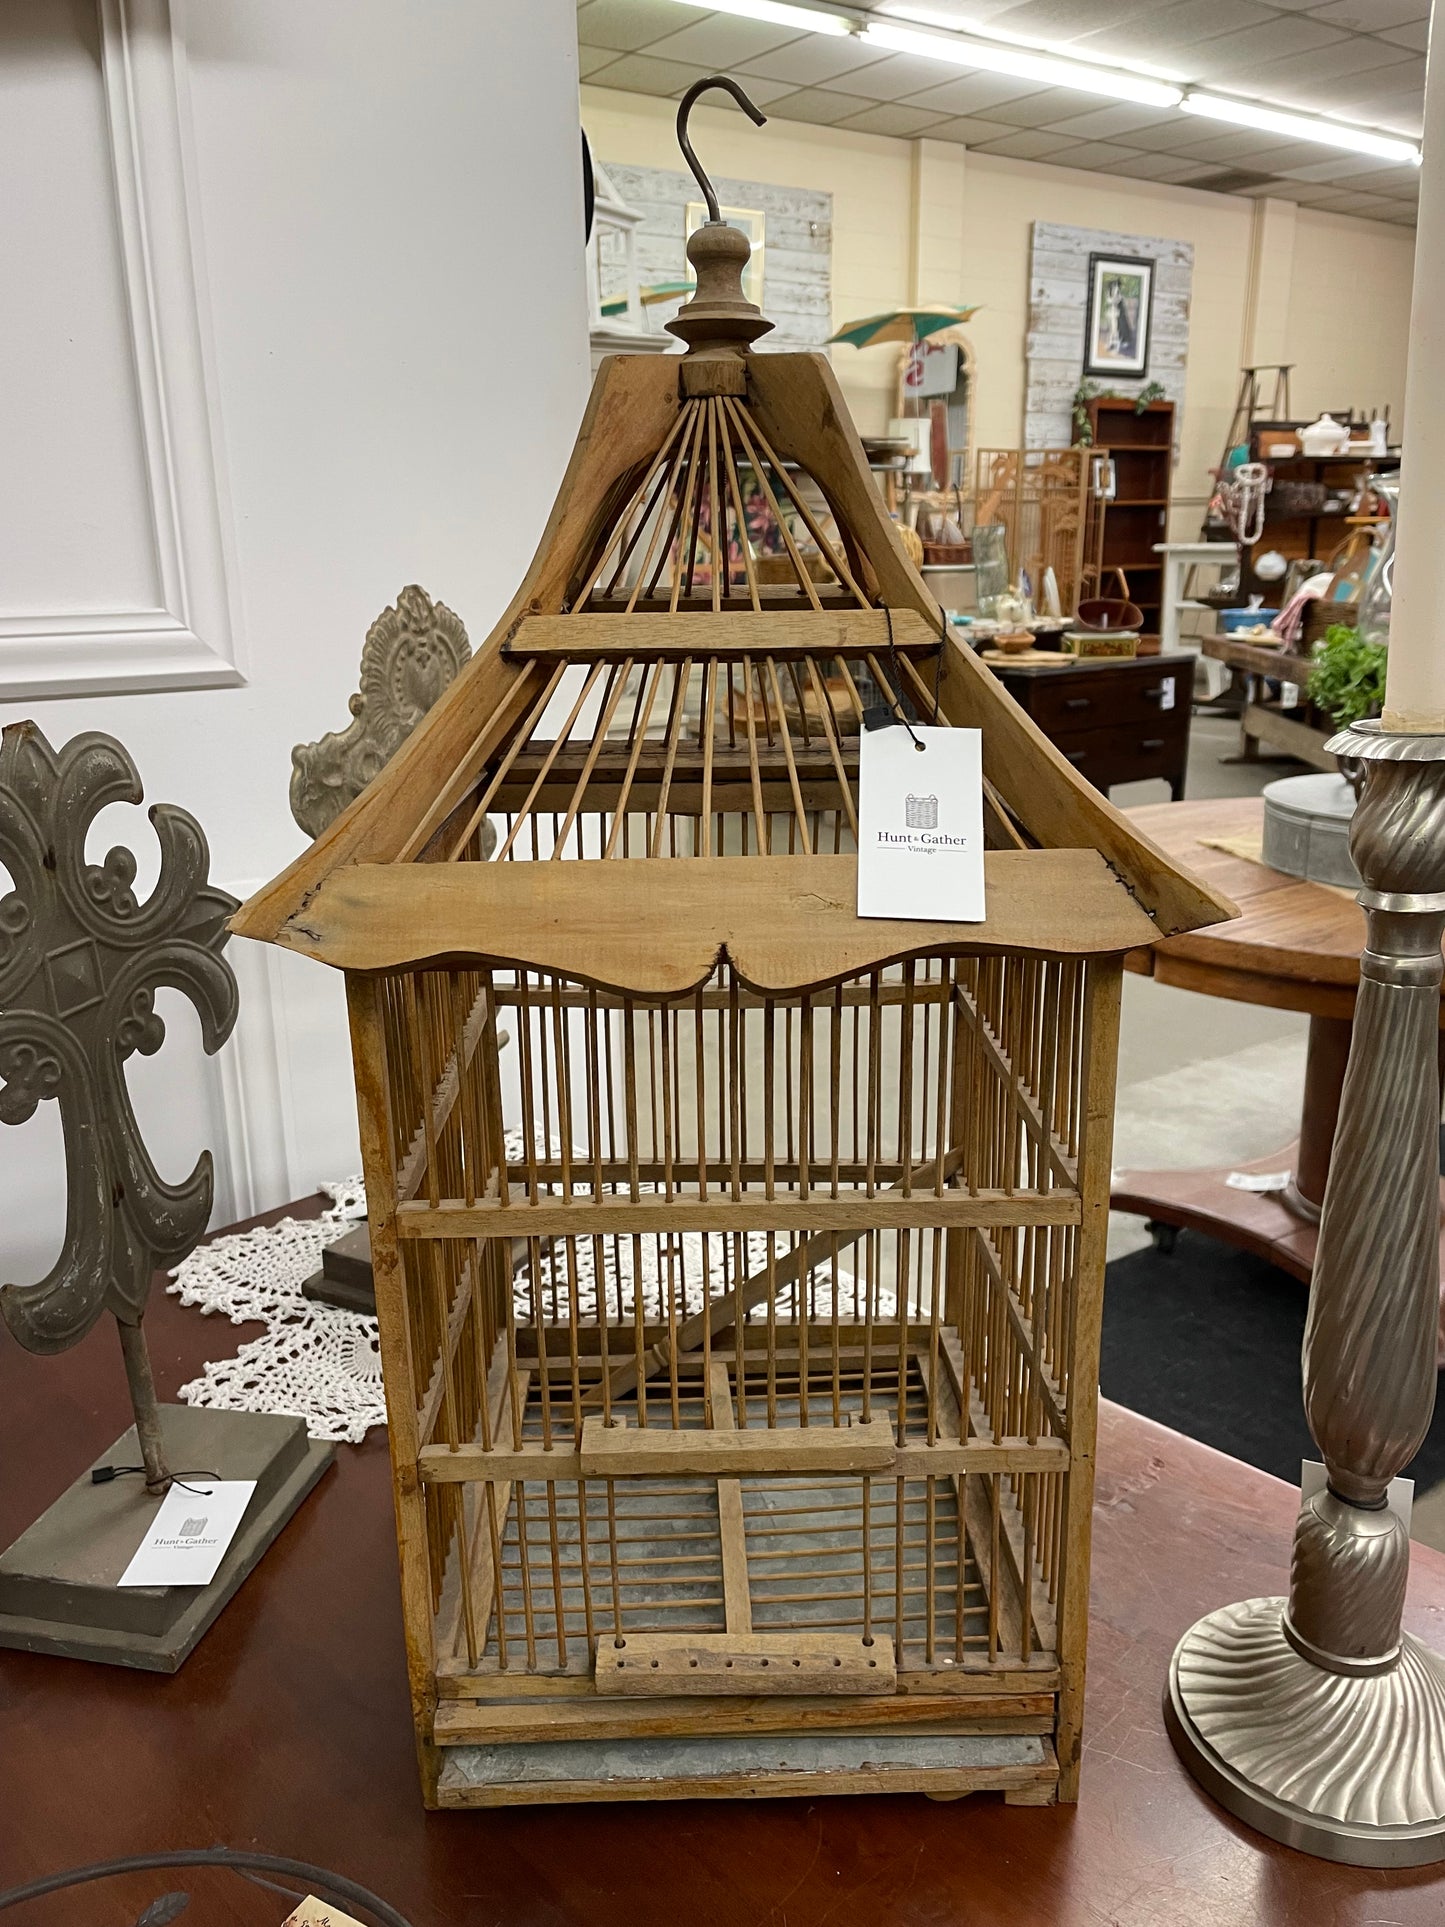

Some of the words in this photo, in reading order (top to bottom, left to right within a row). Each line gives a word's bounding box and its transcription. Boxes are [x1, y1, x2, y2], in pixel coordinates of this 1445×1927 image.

[877, 831, 912, 843] Hunt
[921, 833, 967, 846] Gather
[908, 845, 937, 855] Vintage
